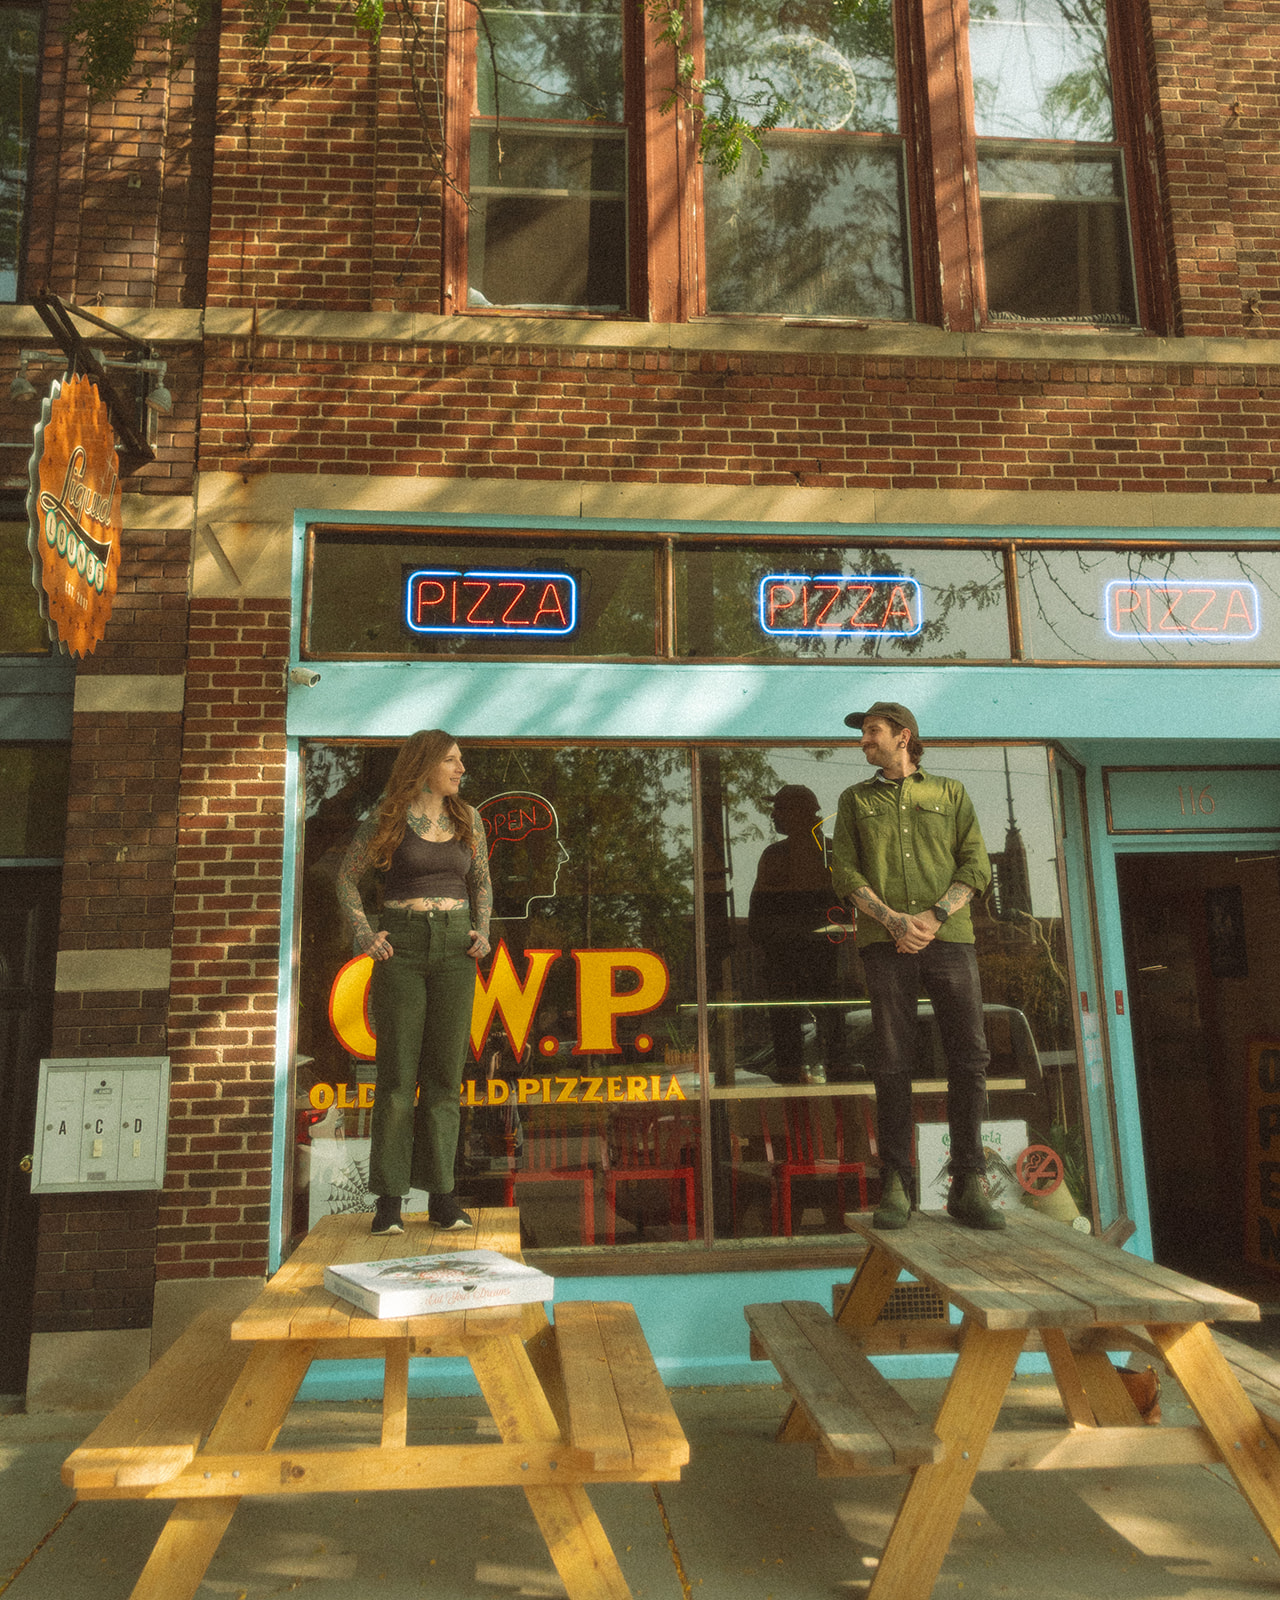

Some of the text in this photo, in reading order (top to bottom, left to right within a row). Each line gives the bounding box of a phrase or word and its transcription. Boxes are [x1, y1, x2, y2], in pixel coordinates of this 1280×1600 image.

[40, 445, 117, 568] Liquid
[48, 516, 103, 586] LOUNGE
[416, 580, 568, 626] PIZZA
[768, 584, 915, 628] PIZZA
[1114, 588, 1254, 632] PIZZA
[1177, 785, 1216, 815] 116
[328, 937, 670, 1062] W.P.
[308, 1082, 377, 1110] OLD
[516, 1073, 688, 1103] PIZZERIA
[58, 1118, 142, 1136] A C D
[425, 1287, 511, 1305] Eat Your Dreams
